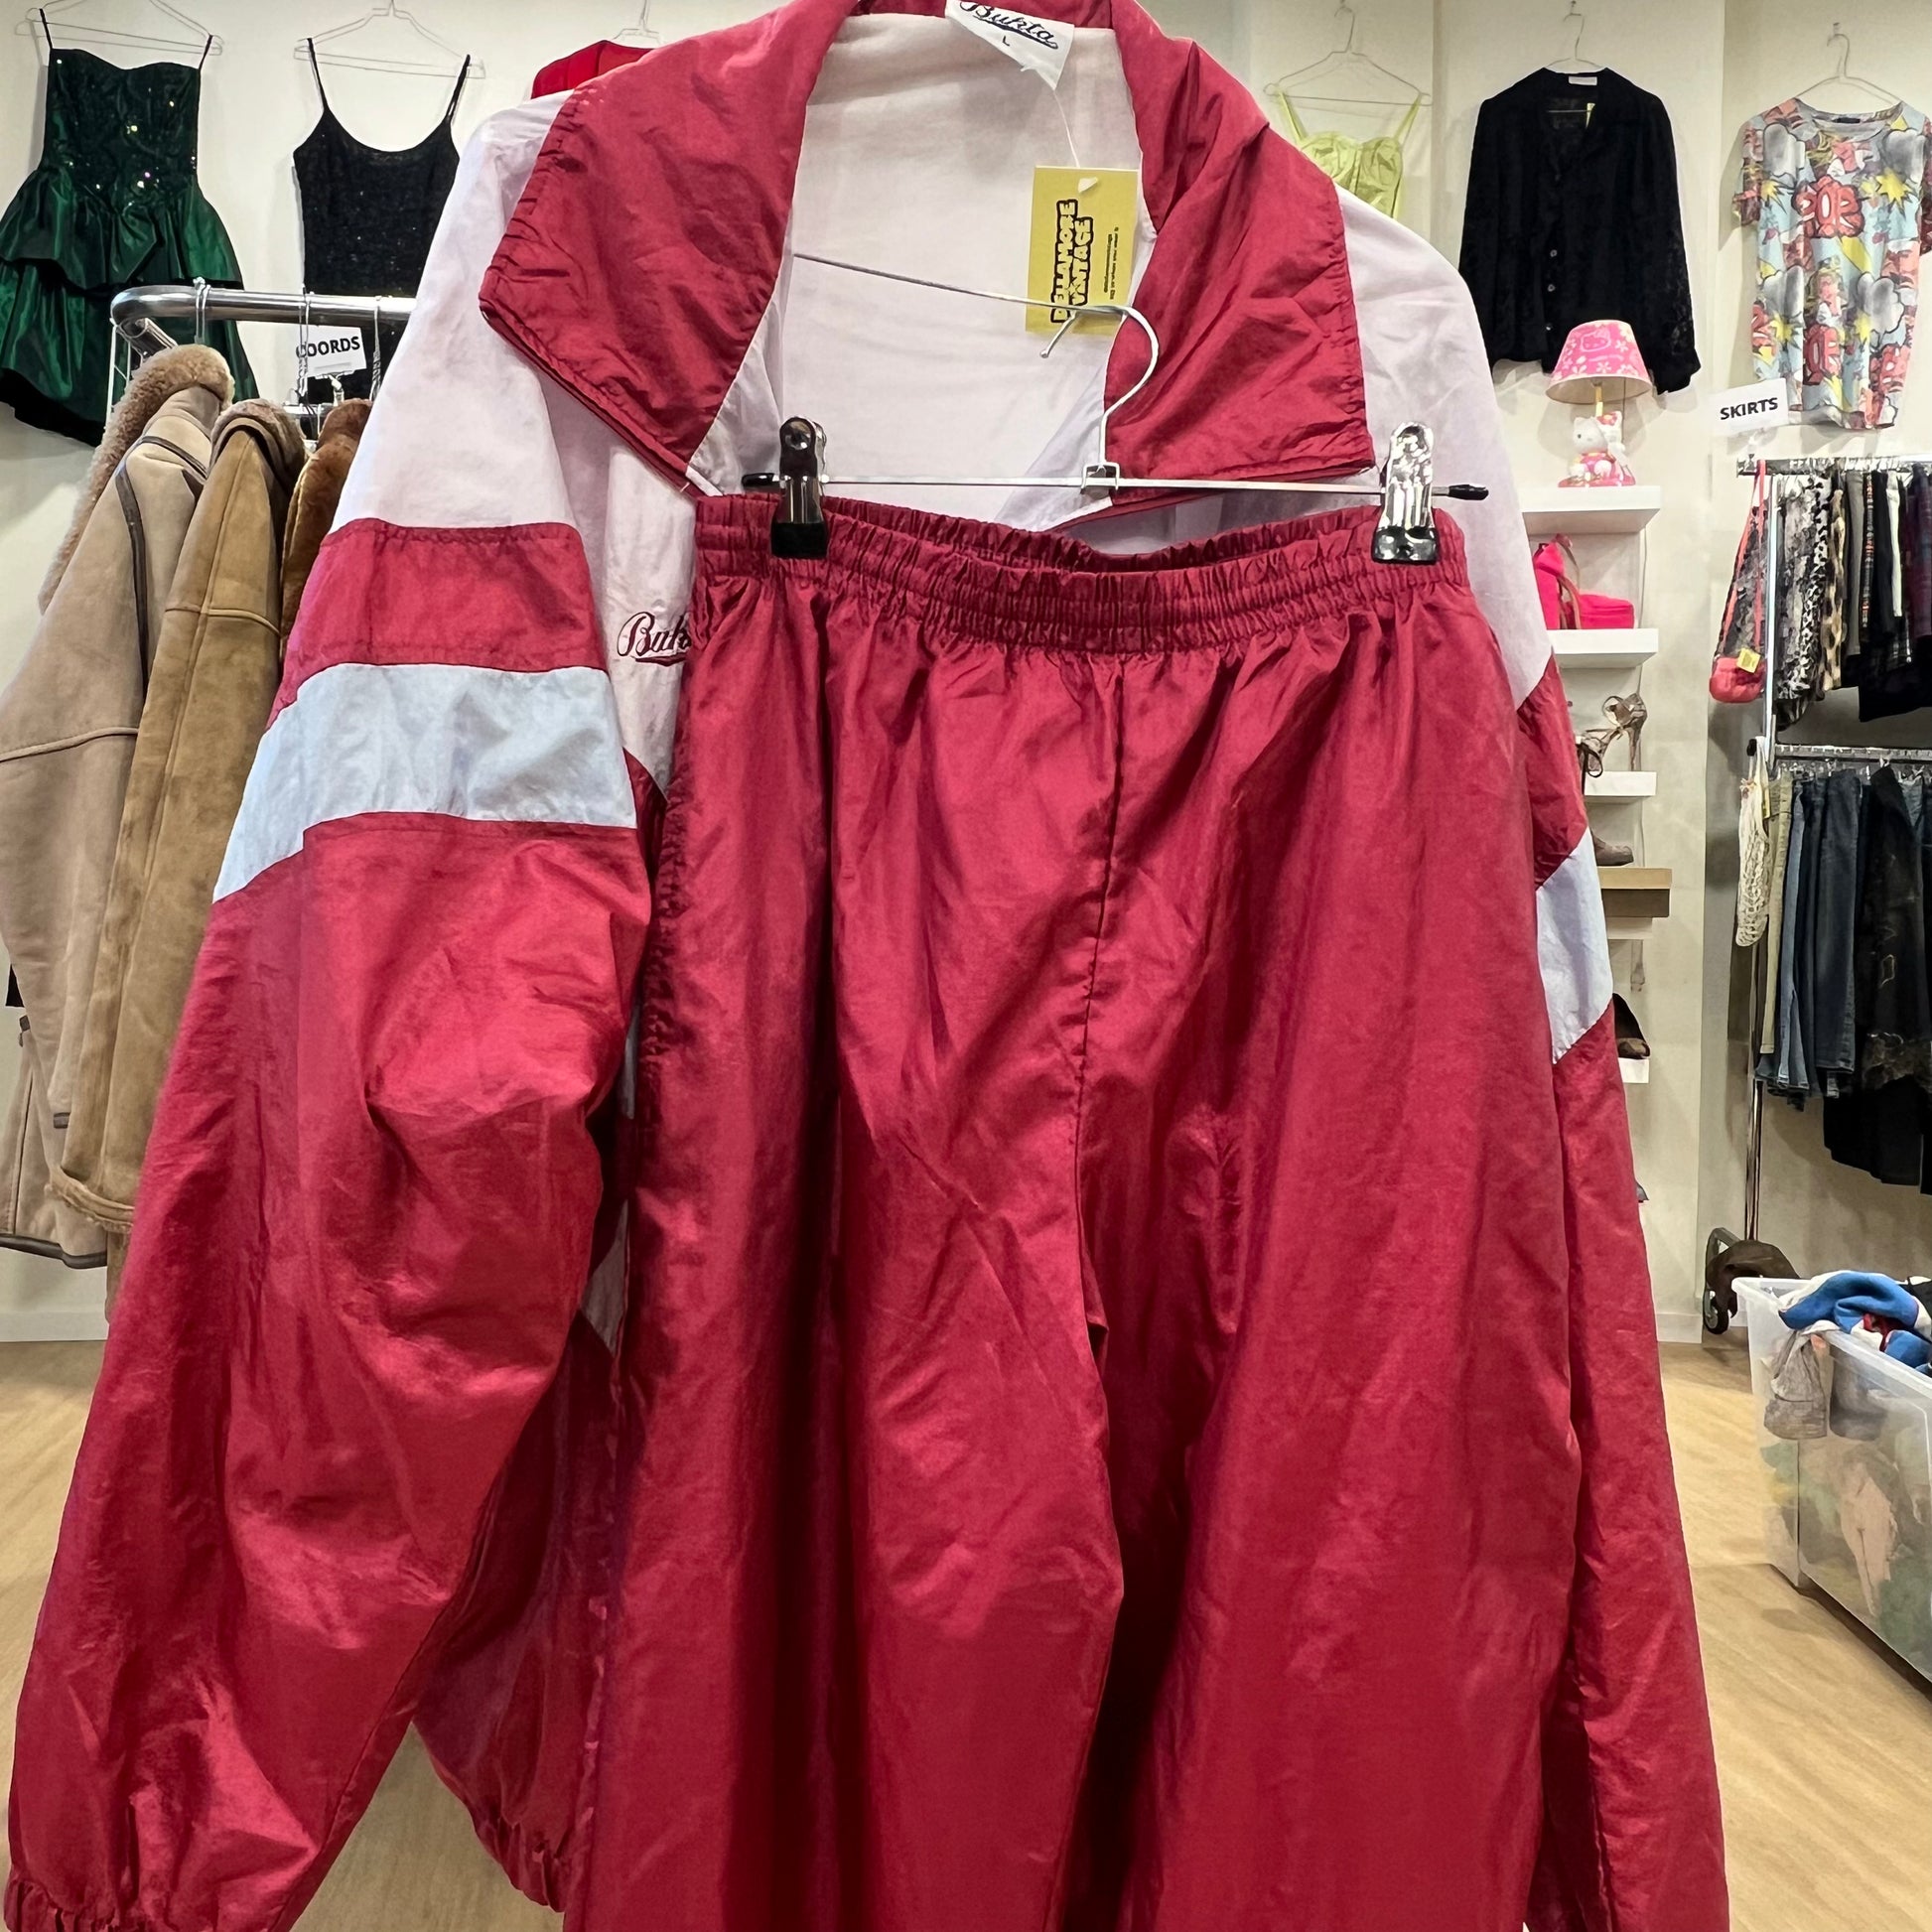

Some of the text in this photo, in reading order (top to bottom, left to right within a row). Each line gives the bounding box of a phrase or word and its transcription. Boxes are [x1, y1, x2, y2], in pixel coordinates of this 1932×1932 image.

[1002, 35, 1011, 47] L
[1720, 397, 1778, 420] SKIRTS
[617, 612, 692, 660] Buk
